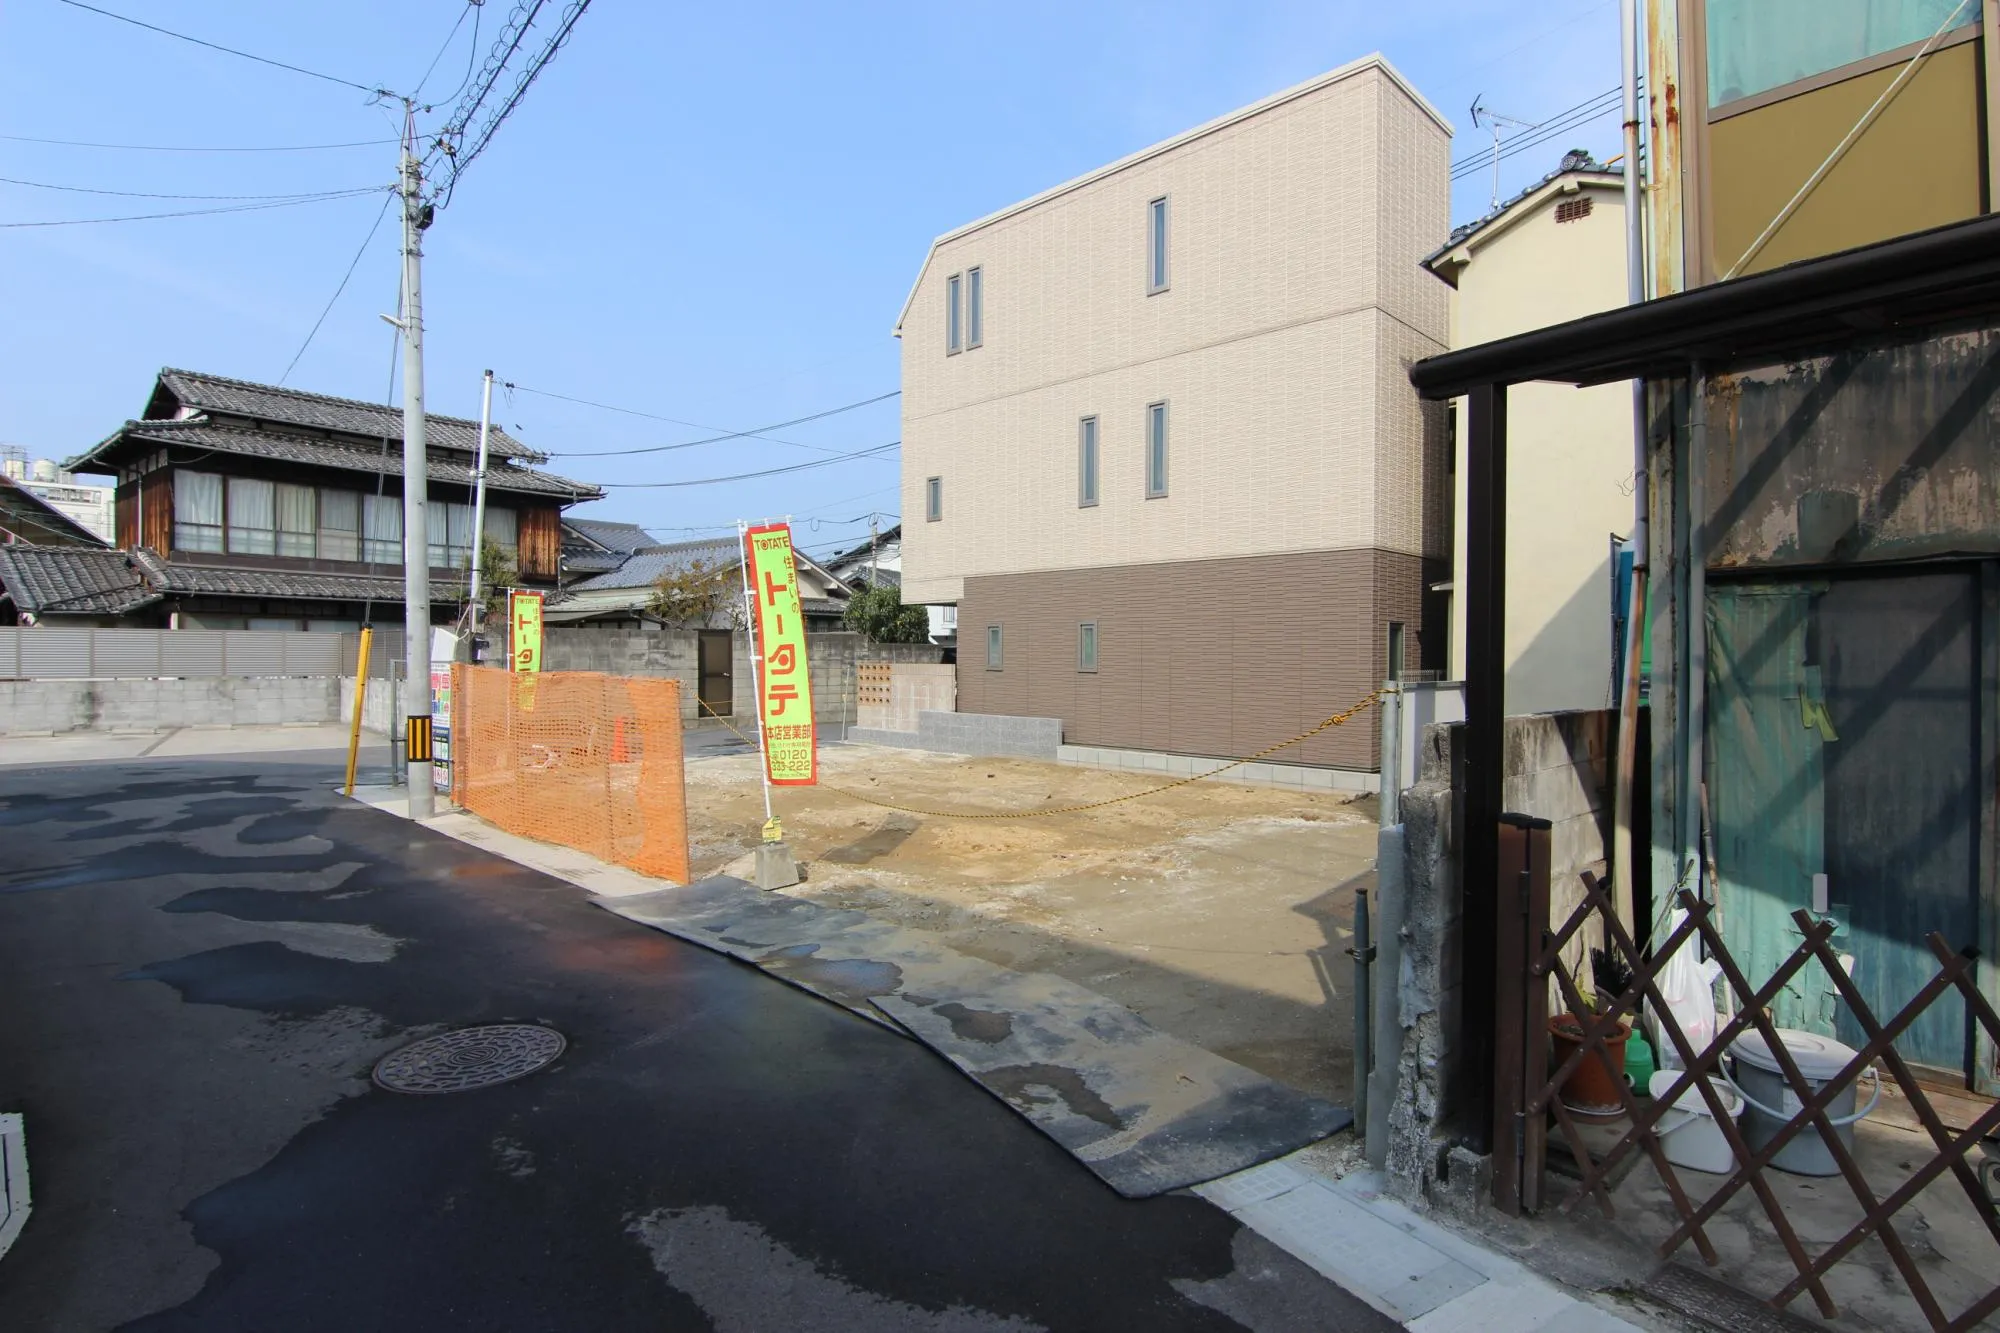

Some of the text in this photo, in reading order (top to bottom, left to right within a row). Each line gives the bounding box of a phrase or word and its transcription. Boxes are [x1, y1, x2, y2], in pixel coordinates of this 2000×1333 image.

[754, 536, 790, 551] TOTATE
[783, 555, 799, 614] 住まいの
[764, 571, 799, 717] トータテ
[780, 749, 808, 760] 0120
